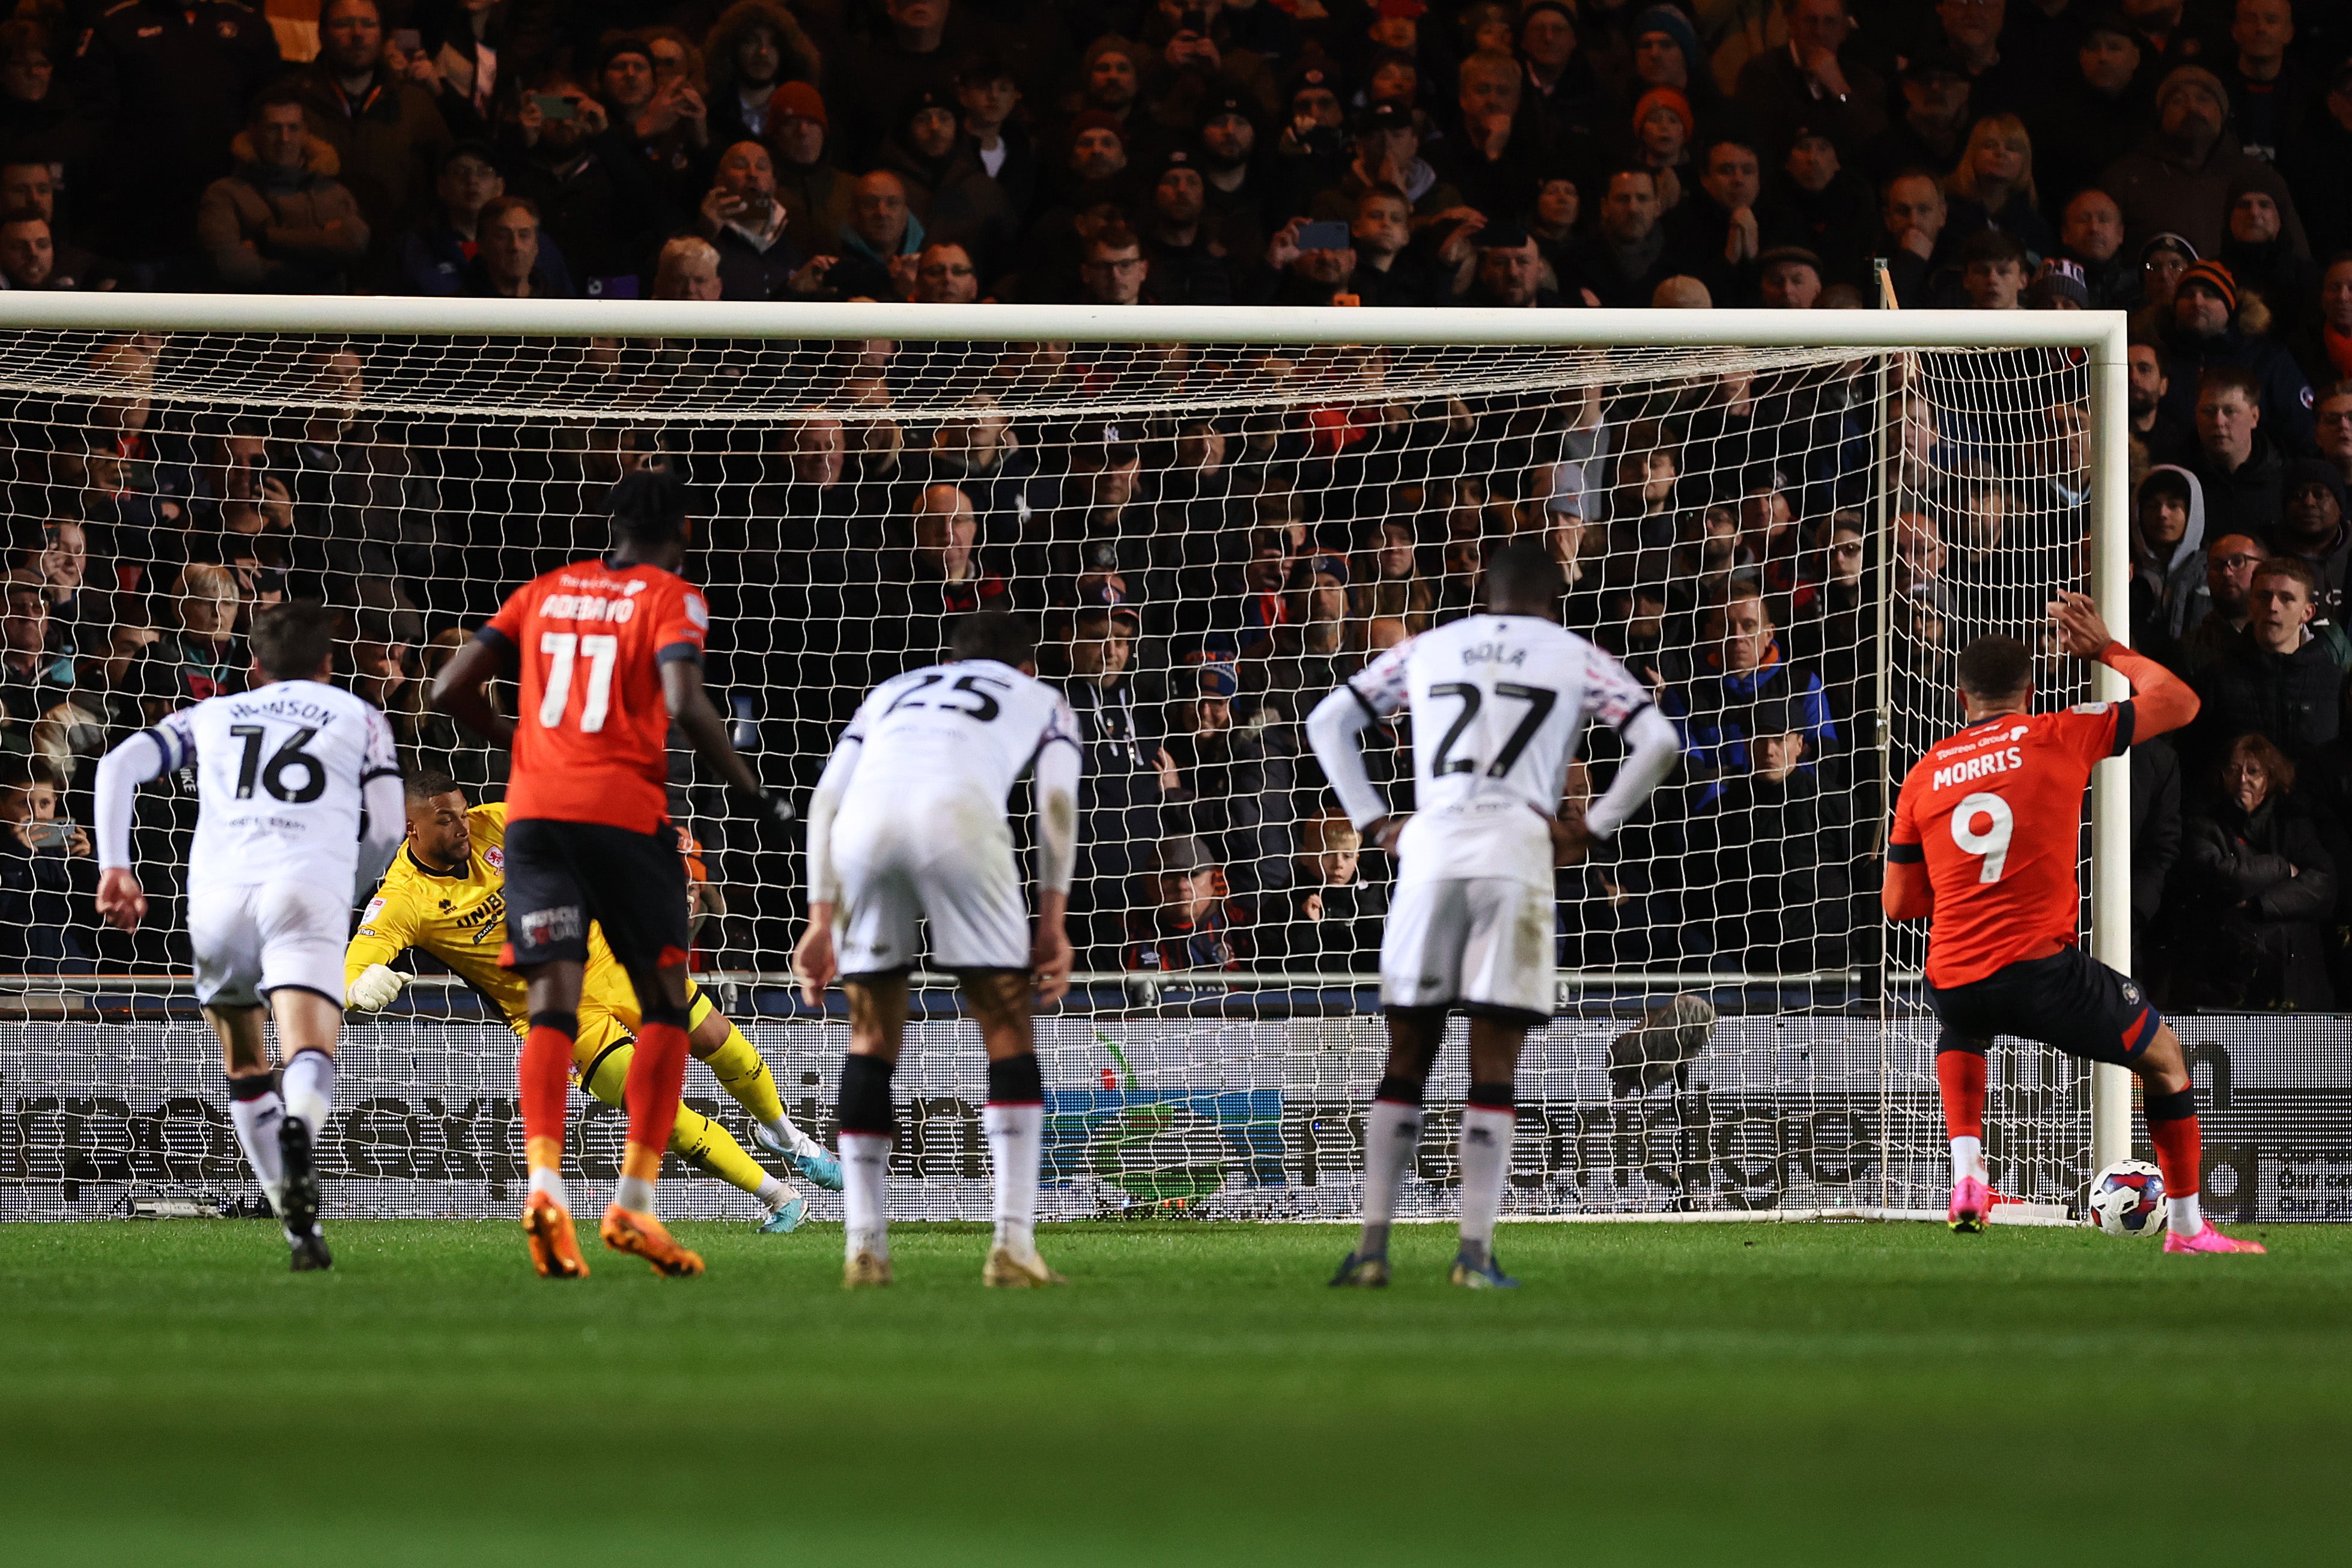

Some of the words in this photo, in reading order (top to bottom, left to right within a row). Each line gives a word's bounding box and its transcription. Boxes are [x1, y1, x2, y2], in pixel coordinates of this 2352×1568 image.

[539, 632, 617, 733] 11
[881, 674, 1012, 722] 25
[231, 725, 326, 803] 16
[1430, 682, 1556, 779] 27
[1933, 746, 2022, 791] MORRIS
[1951, 792, 2014, 884] 9
[457, 893, 502, 928] UNIB
